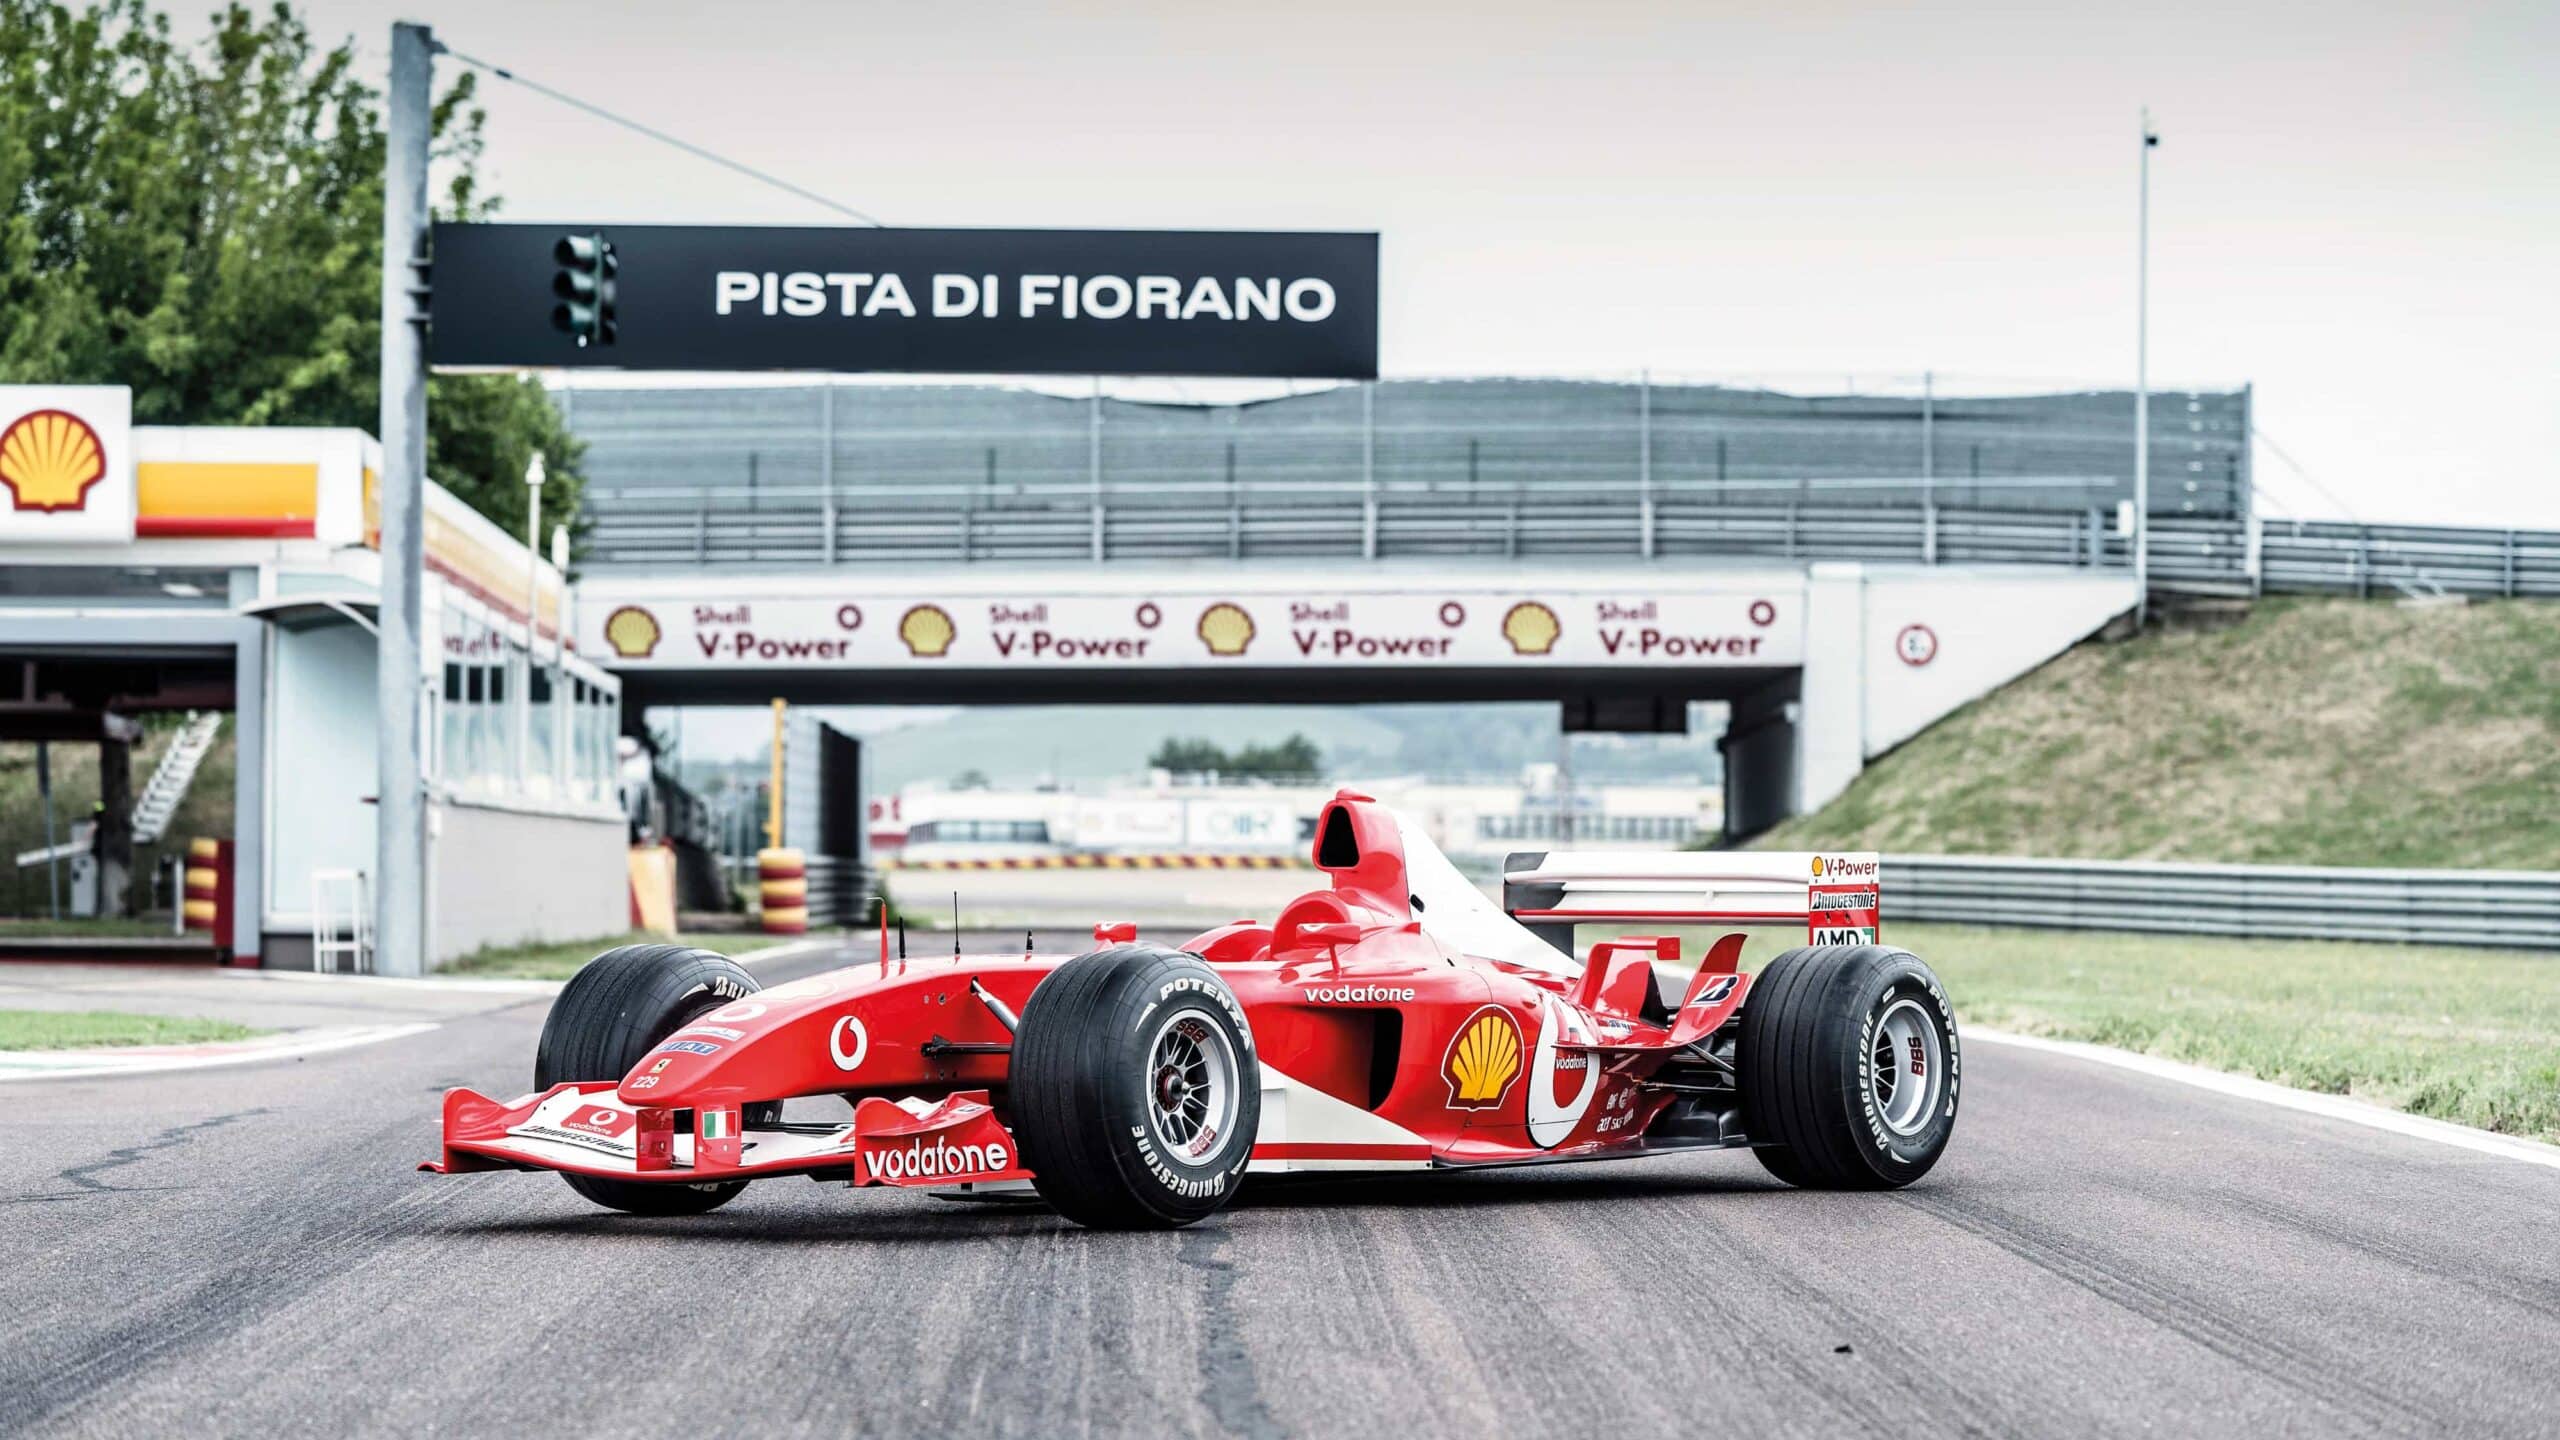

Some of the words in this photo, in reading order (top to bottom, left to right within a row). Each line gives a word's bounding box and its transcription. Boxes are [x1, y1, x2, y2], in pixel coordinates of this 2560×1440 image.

[715, 271, 917, 317] PISTA
[932, 273, 999, 318] DI
[1020, 274, 1337, 322] FIORANO
[693, 604, 751, 626] Shell
[989, 602, 1048, 624] Shell
[1291, 601, 1349, 622] Shell
[1597, 600, 1657, 623] Shell
[696, 632, 851, 660] V-Power
[991, 630, 1150, 658] V-Power
[1292, 629, 1453, 657] V-Power
[1599, 628, 1764, 656] V-Power
[1825, 858, 1877, 876] V-Power
[1812, 892, 1876, 910] BRIDGESTONE
[711, 975, 752, 1000] BRI
[1304, 984, 1416, 1002] vodafone
[1160, 977, 1251, 1051] POTENZA
[1555, 1054, 1587, 1069] vodafone
[1907, 1036, 1925, 1077] BBS
[1928, 986, 1959, 1117] POTENZA
[630, 1075, 660, 1089] 229
[568, 1121, 613, 1136] vodafone
[864, 1135, 1008, 1178] vodafone
[1132, 1124, 1225, 1198] BRIDGESTONE
